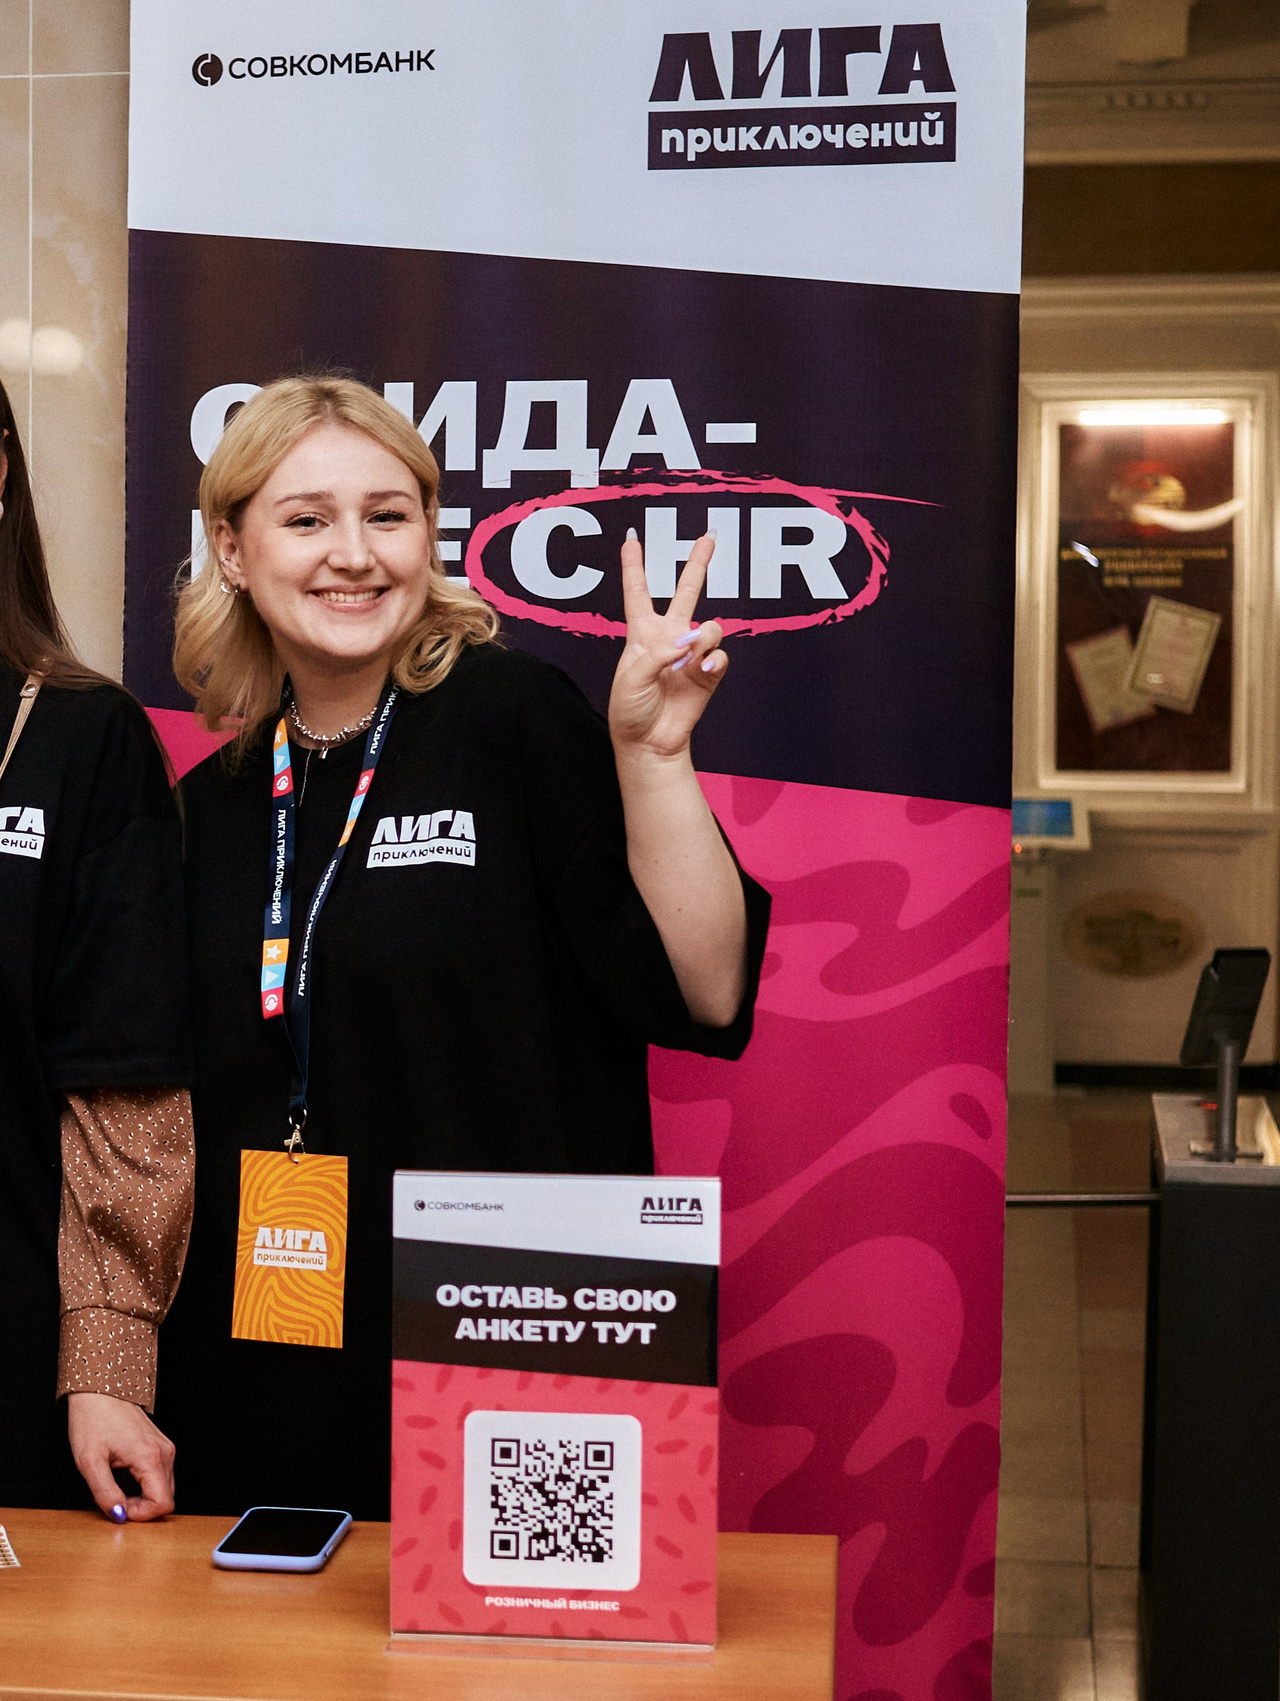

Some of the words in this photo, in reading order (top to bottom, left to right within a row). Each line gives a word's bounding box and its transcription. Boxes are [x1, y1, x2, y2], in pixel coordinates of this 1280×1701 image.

[228, 49, 436, 80] СОВКОМБАНК
[648, 23, 956, 102] ЛИГА
[661, 112, 944, 161] приключений
[644, 507, 850, 600] HR
[370, 723, 385, 754] ЛИГА
[277, 809, 286, 837] ЛИГА
[371, 810, 476, 845] ЛИГА
[373, 846, 471, 862] приключений
[271, 839, 286, 925] ПРИКЛЮЧЕНИЙ
[298, 961, 307, 997] ЛИГА
[427, 1201, 505, 1211] СОВКОМБАНК
[641, 1197, 703, 1212] ЛИГА
[254, 1227, 327, 1252] ЛИГА
[257, 1254, 324, 1265] приключений
[436, 1284, 568, 1310] ОСТАВЬ
[573, 1288, 677, 1312] СВОЮ
[455, 1318, 586, 1343] АНКЕТУ
[592, 1322, 657, 1344] ТУТ
[485, 1596, 568, 1611] РОЗНИЧНЫЙ
[569, 1600, 621, 1612] БИЗНЕС
